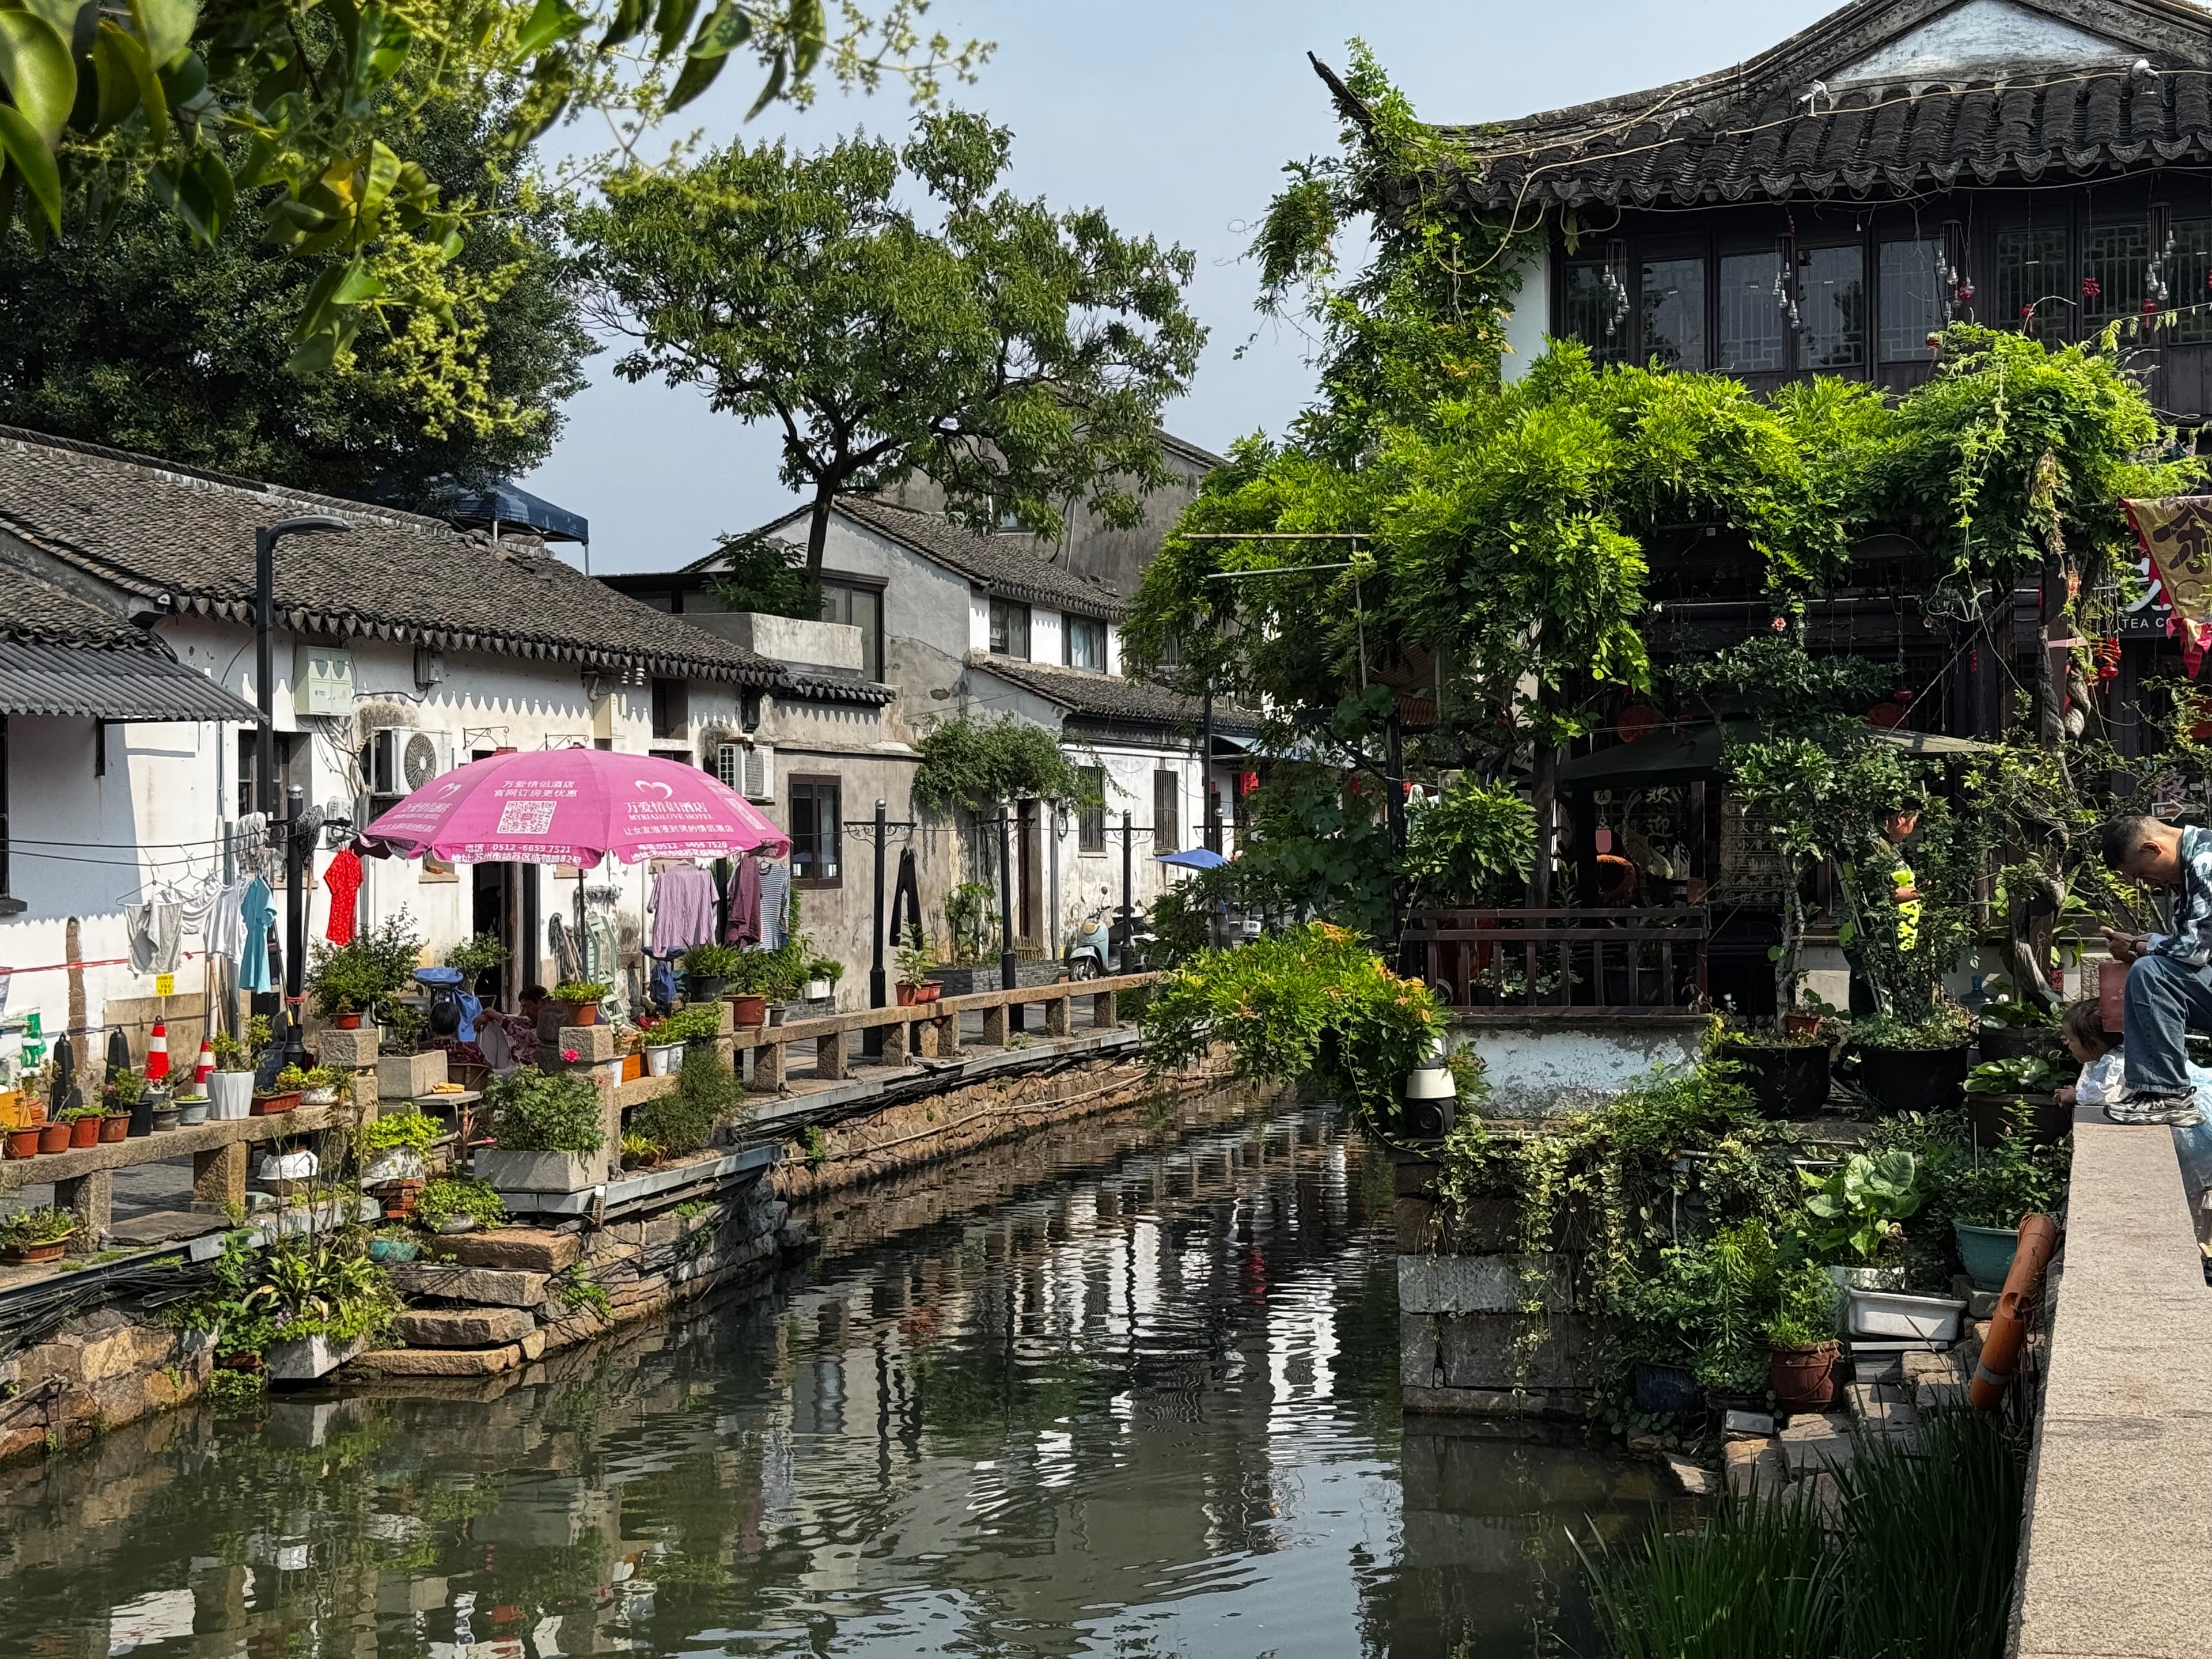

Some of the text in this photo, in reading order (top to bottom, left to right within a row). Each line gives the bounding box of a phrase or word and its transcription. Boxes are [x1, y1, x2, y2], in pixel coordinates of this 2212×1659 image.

[2153, 498, 2212, 574] 茶
[2122, 618, 2149, 628] TEA
[502, 781, 575, 789] 万爱情侣酒店
[494, 789, 578, 797] 官网订房更优惠
[1646, 785, 1673, 838] 欢迎
[549, 845, 571, 853] 7521
